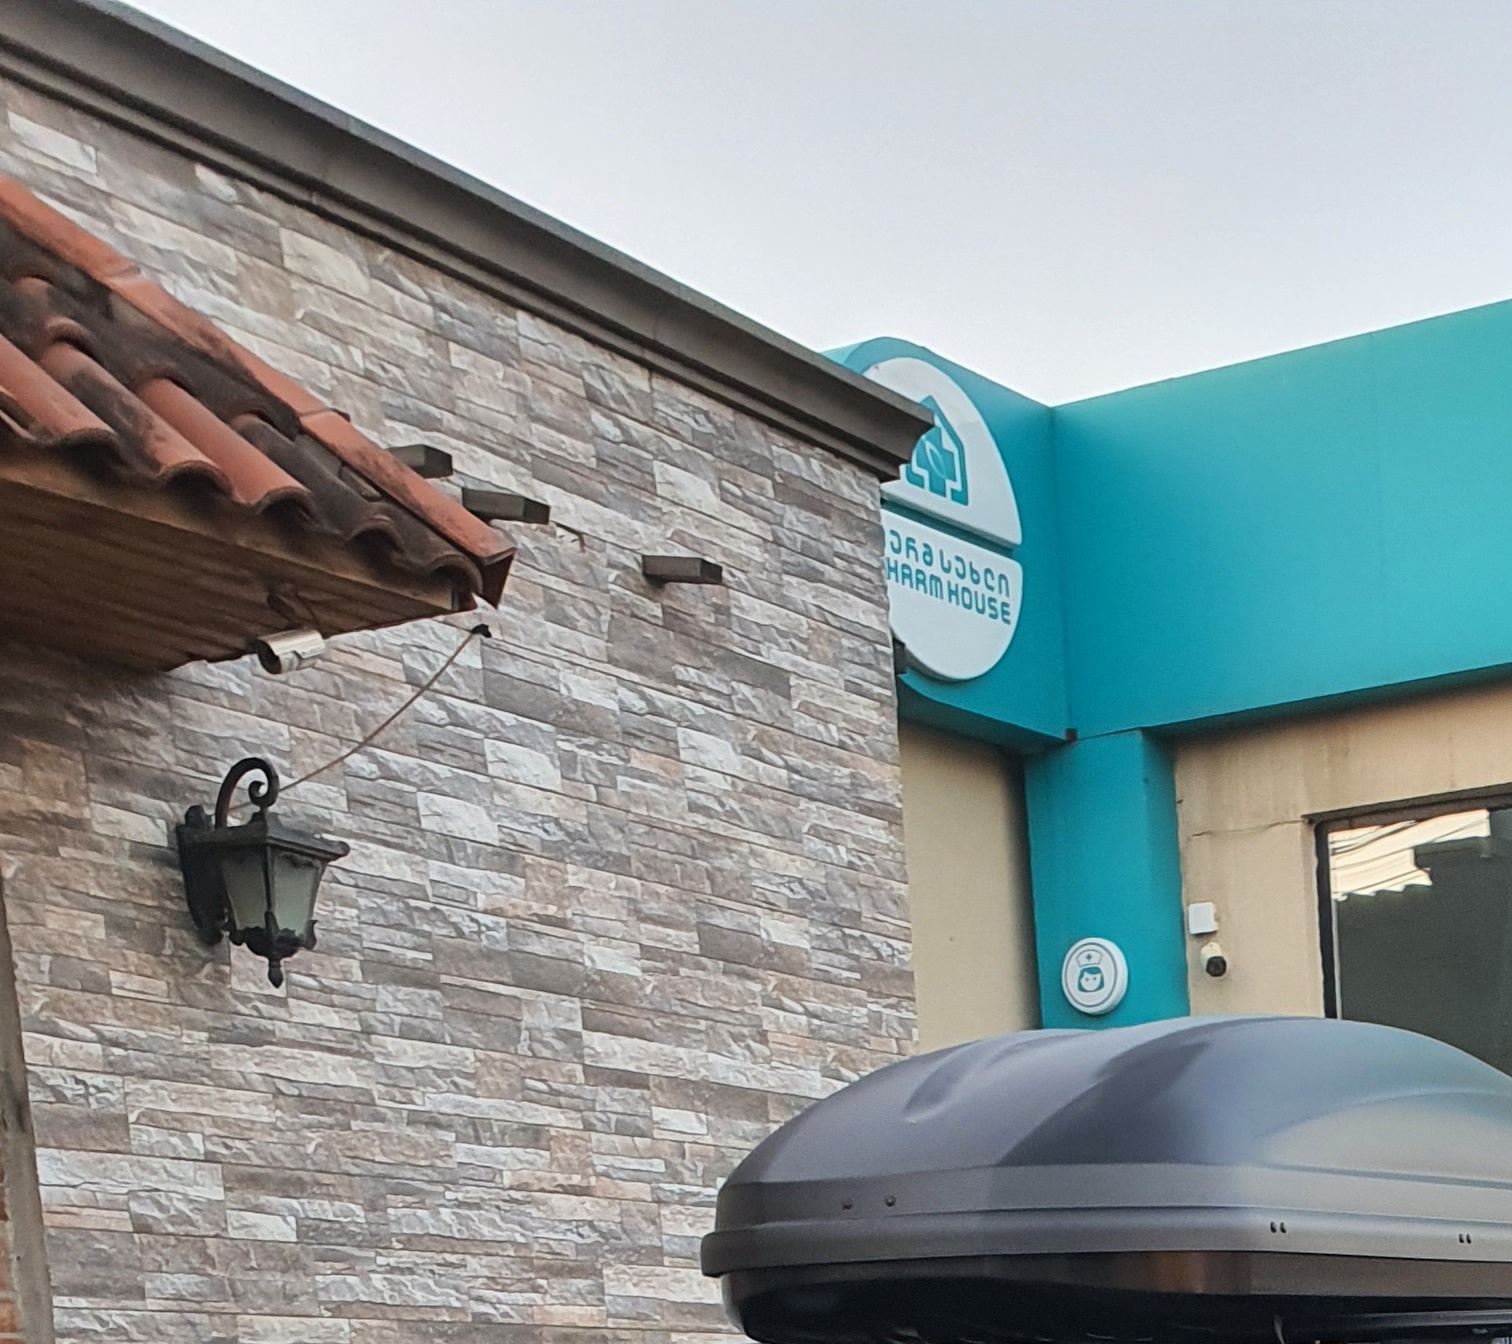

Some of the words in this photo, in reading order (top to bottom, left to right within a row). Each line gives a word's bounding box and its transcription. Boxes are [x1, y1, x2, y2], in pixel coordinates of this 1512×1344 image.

[889, 528, 933, 567] არმ
[886, 557, 944, 600] HARM
[947, 579, 1011, 625] HOUSE
